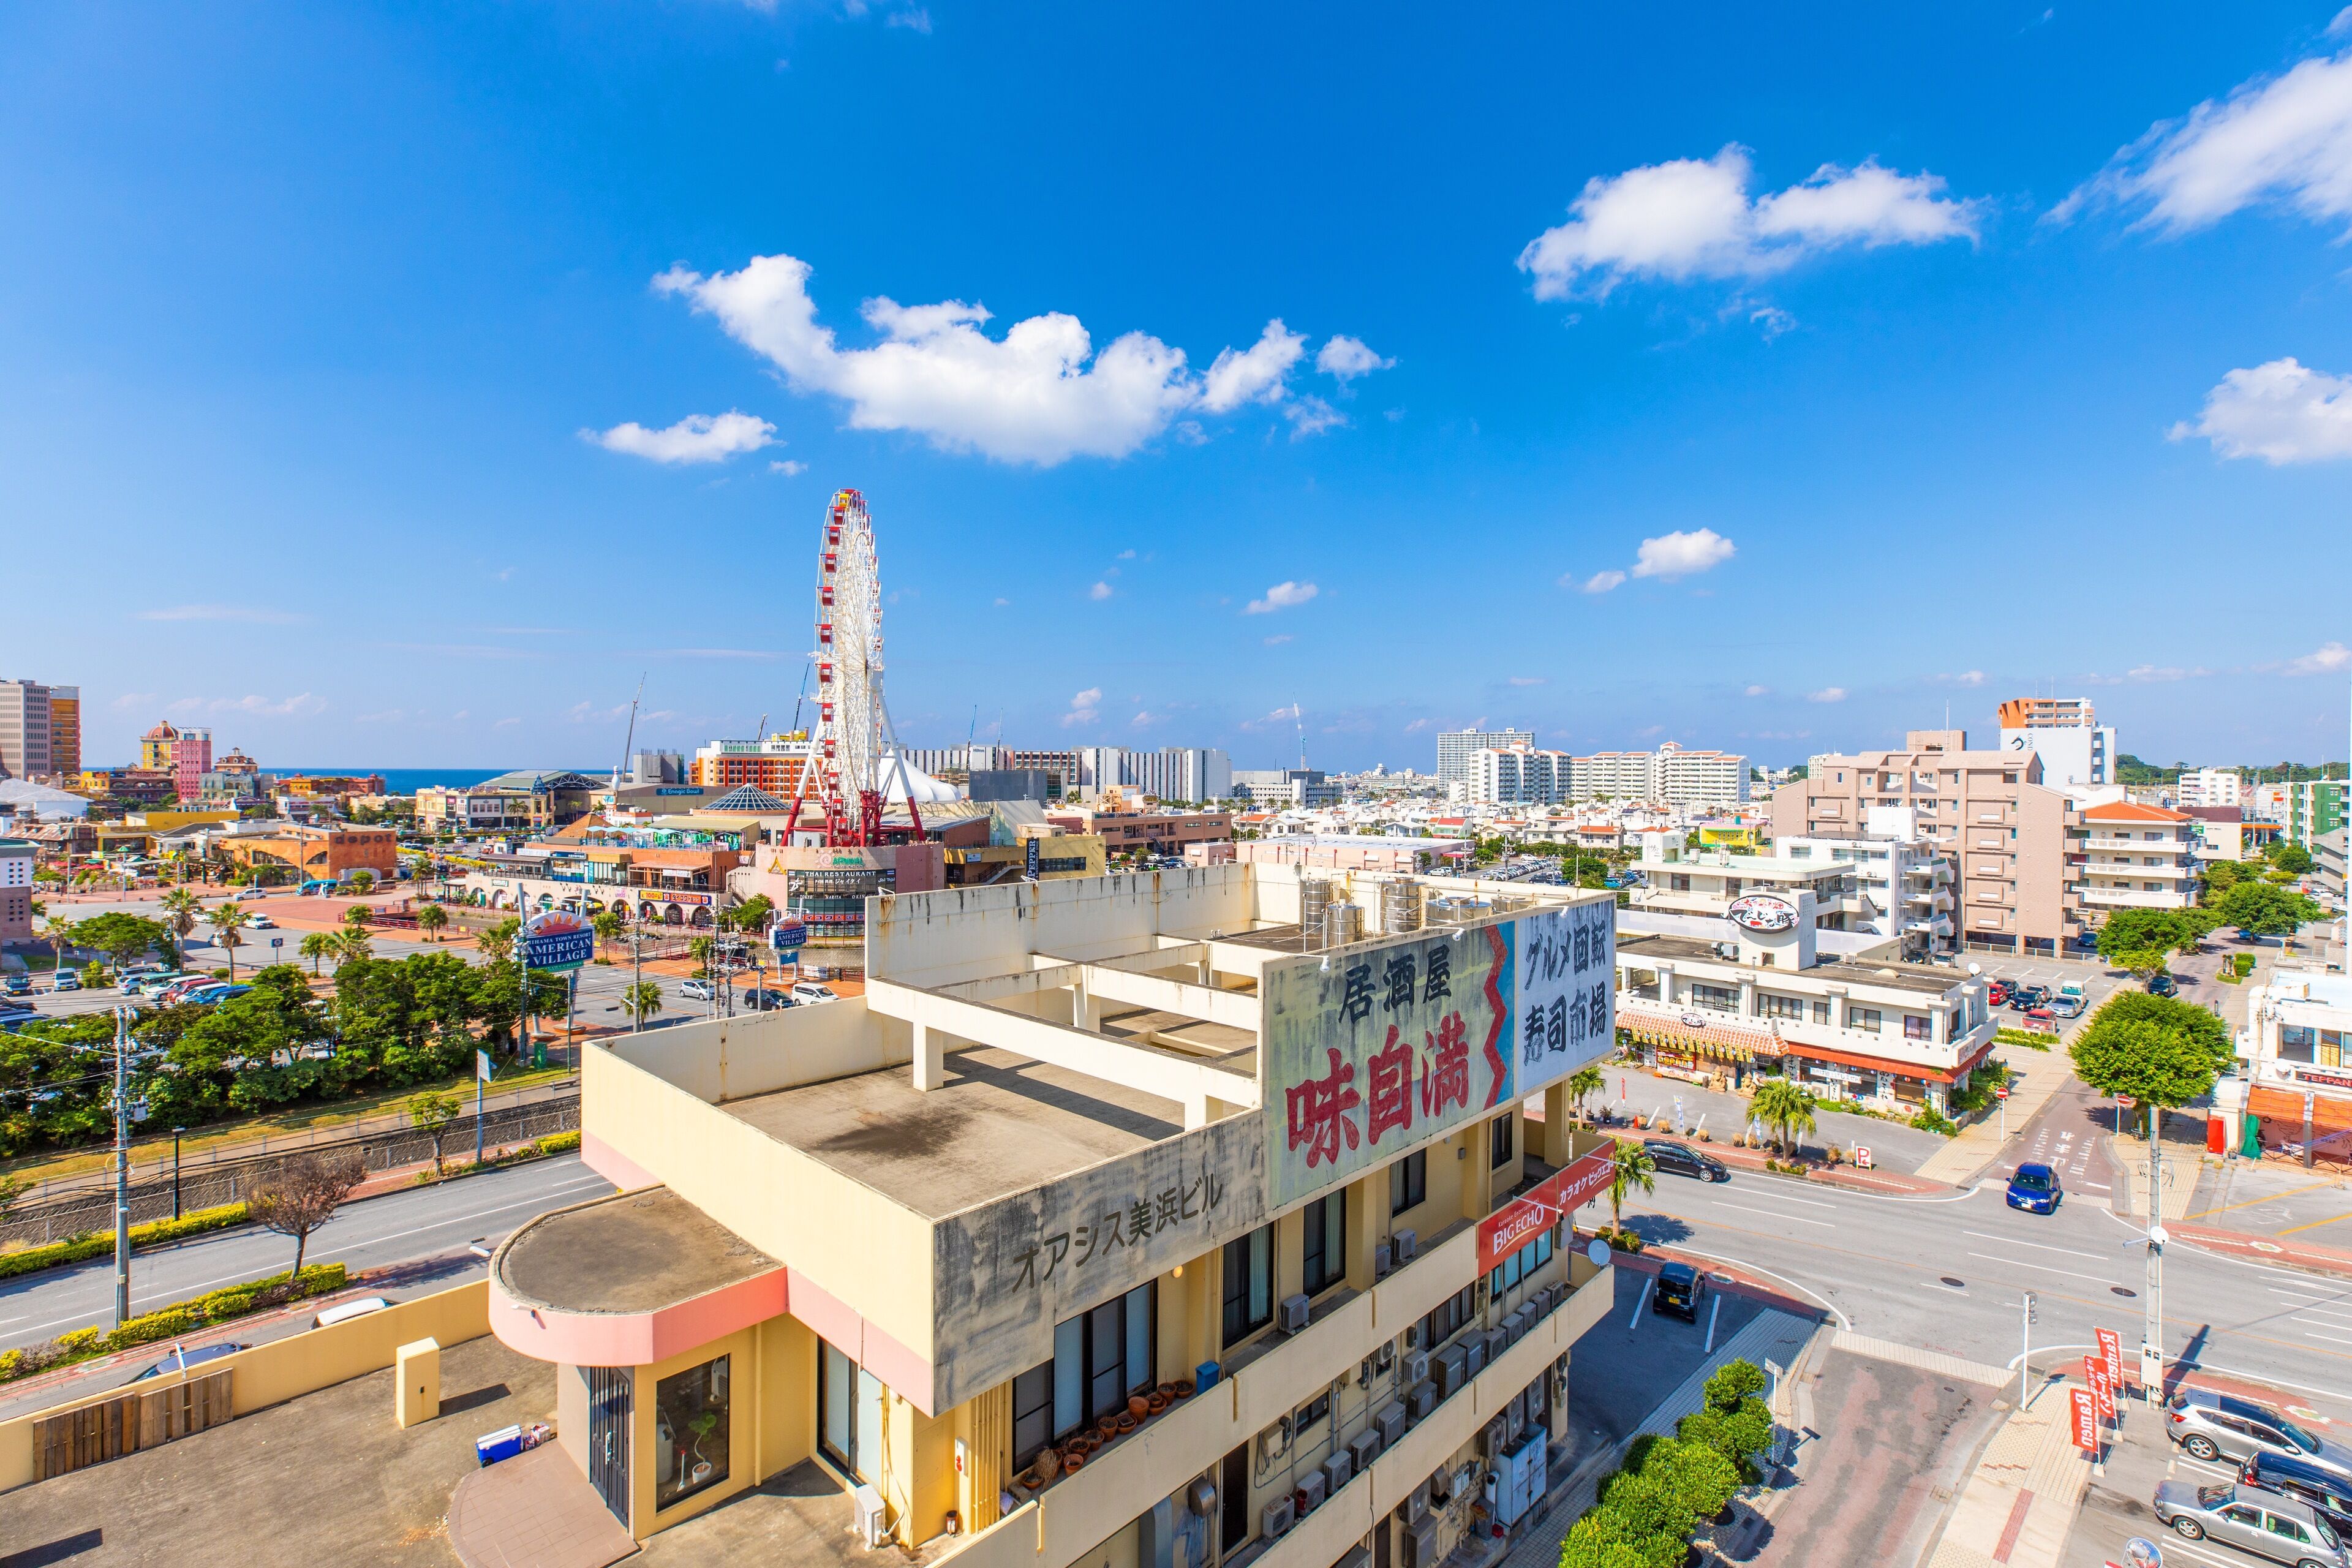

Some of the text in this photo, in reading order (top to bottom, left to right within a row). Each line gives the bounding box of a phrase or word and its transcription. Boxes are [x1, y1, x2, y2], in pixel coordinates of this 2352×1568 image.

[334, 833, 393, 846] depot
[1027, 840, 1036, 878] PEPPER
[527, 938, 592, 955] AMERICAN
[777, 931, 807, 941] AMERICAN
[781, 937, 805, 946] VILLAGE
[533, 949, 587, 965] VILLAGE
[1524, 920, 1607, 992] グルメ回転
[1338, 943, 1452, 1024] 居酒屋
[1523, 980, 1607, 1066] 寿司市場
[1284, 1009, 1470, 1169] 味自満
[1857, 1147, 1869, 1164] P
[1559, 1177, 1588, 1205] カラオケ
[1011, 1172, 1223, 1294] オアシス美浜ビル
[1493, 1204, 1544, 1256] BIG ECHO
[1498, 1215, 1513, 1227] Karaoke
